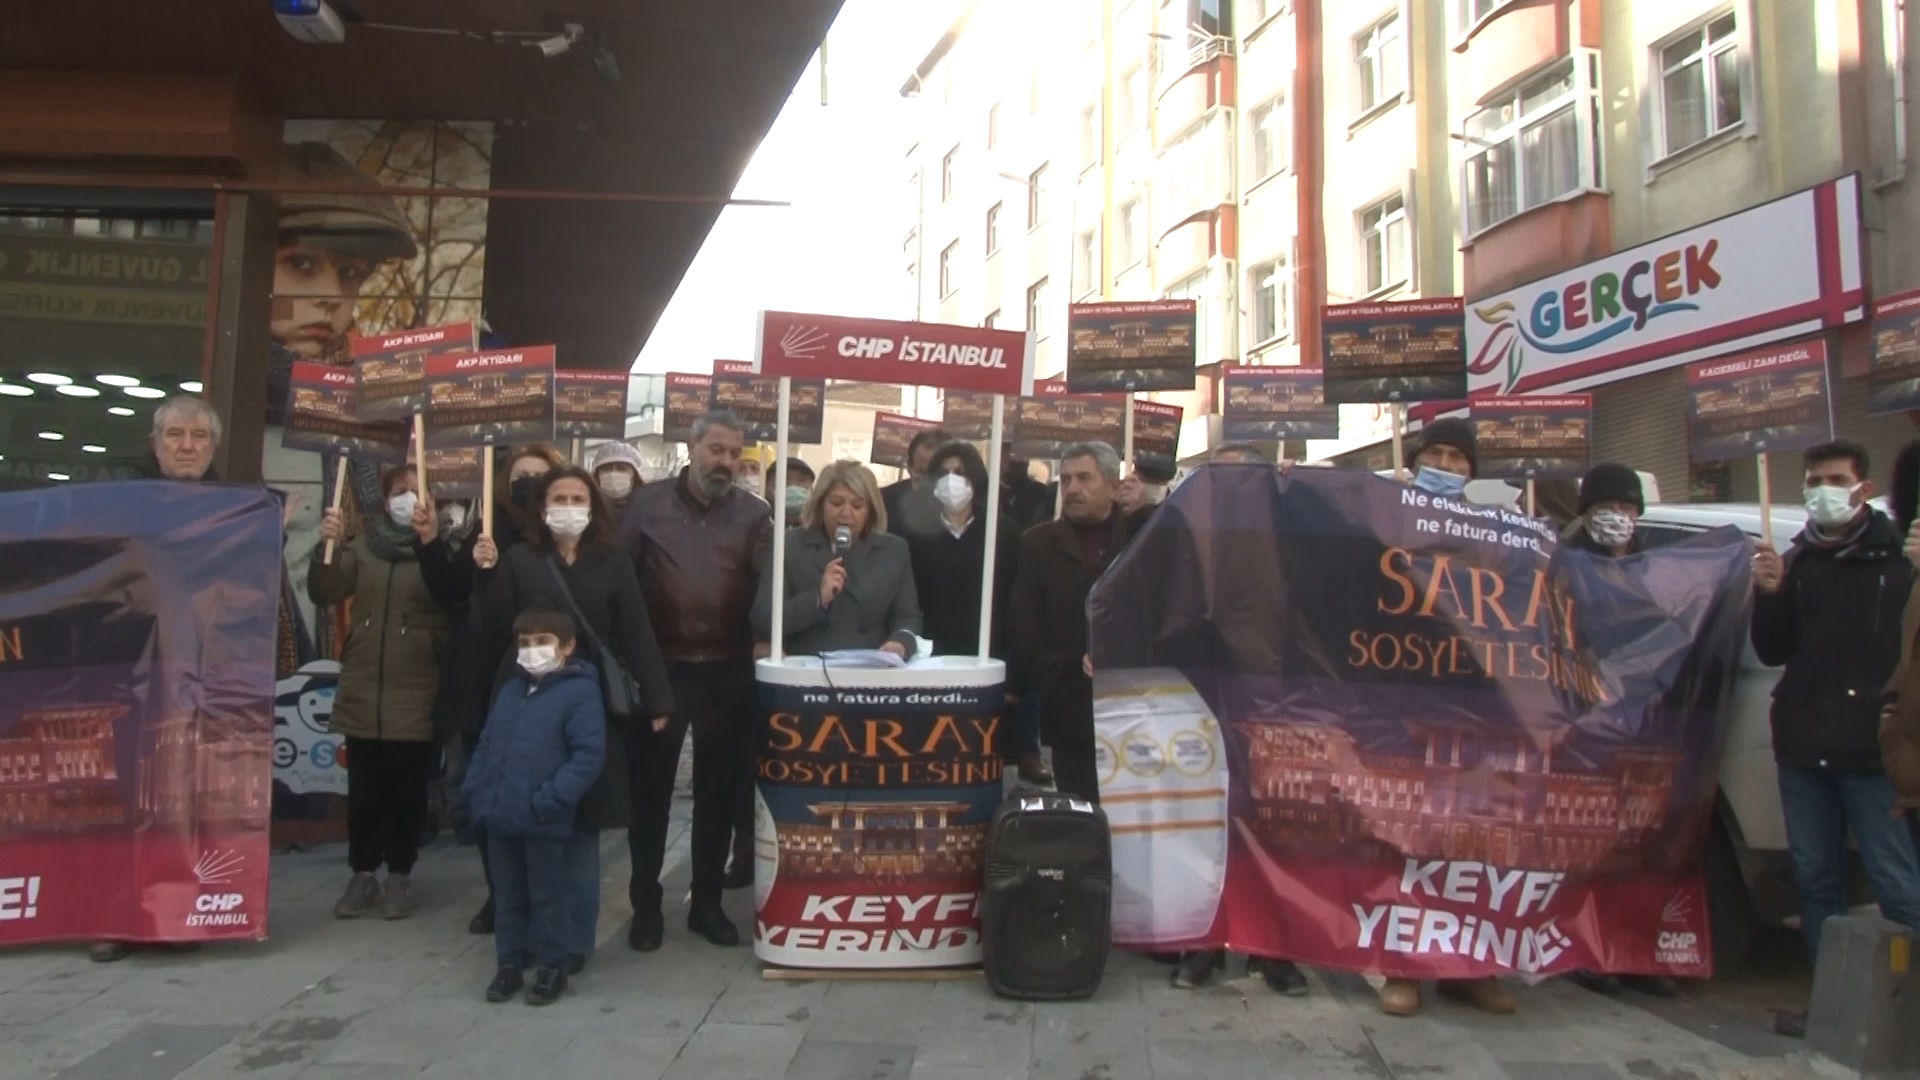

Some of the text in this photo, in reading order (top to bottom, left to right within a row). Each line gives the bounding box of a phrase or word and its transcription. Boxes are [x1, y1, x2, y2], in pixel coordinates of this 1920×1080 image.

[1529, 239, 1722, 338] GERÇEK
[382, 336, 403, 349] AKP
[837, 335, 1008, 369] CHP İSTANBUL
[456, 356, 479, 369] AKP
[1753, 355, 1777, 369] ZAM
[1402, 489, 1428, 508] Ne
[1417, 518, 1440, 533] ne
[1445, 519, 1498, 543] fatura
[1378, 547, 1575, 650] SARAY
[803, 693, 830, 704] ne
[837, 691, 900, 705] fatura
[769, 713, 1001, 758] SARAY
[196, 893, 244, 912] CHP
[186, 911, 249, 927] İSTANBUL
[757, 919, 983, 952] YERİND
[1352, 903, 1573, 974] YERİNDE!
[1657, 931, 1698, 950] CHP
